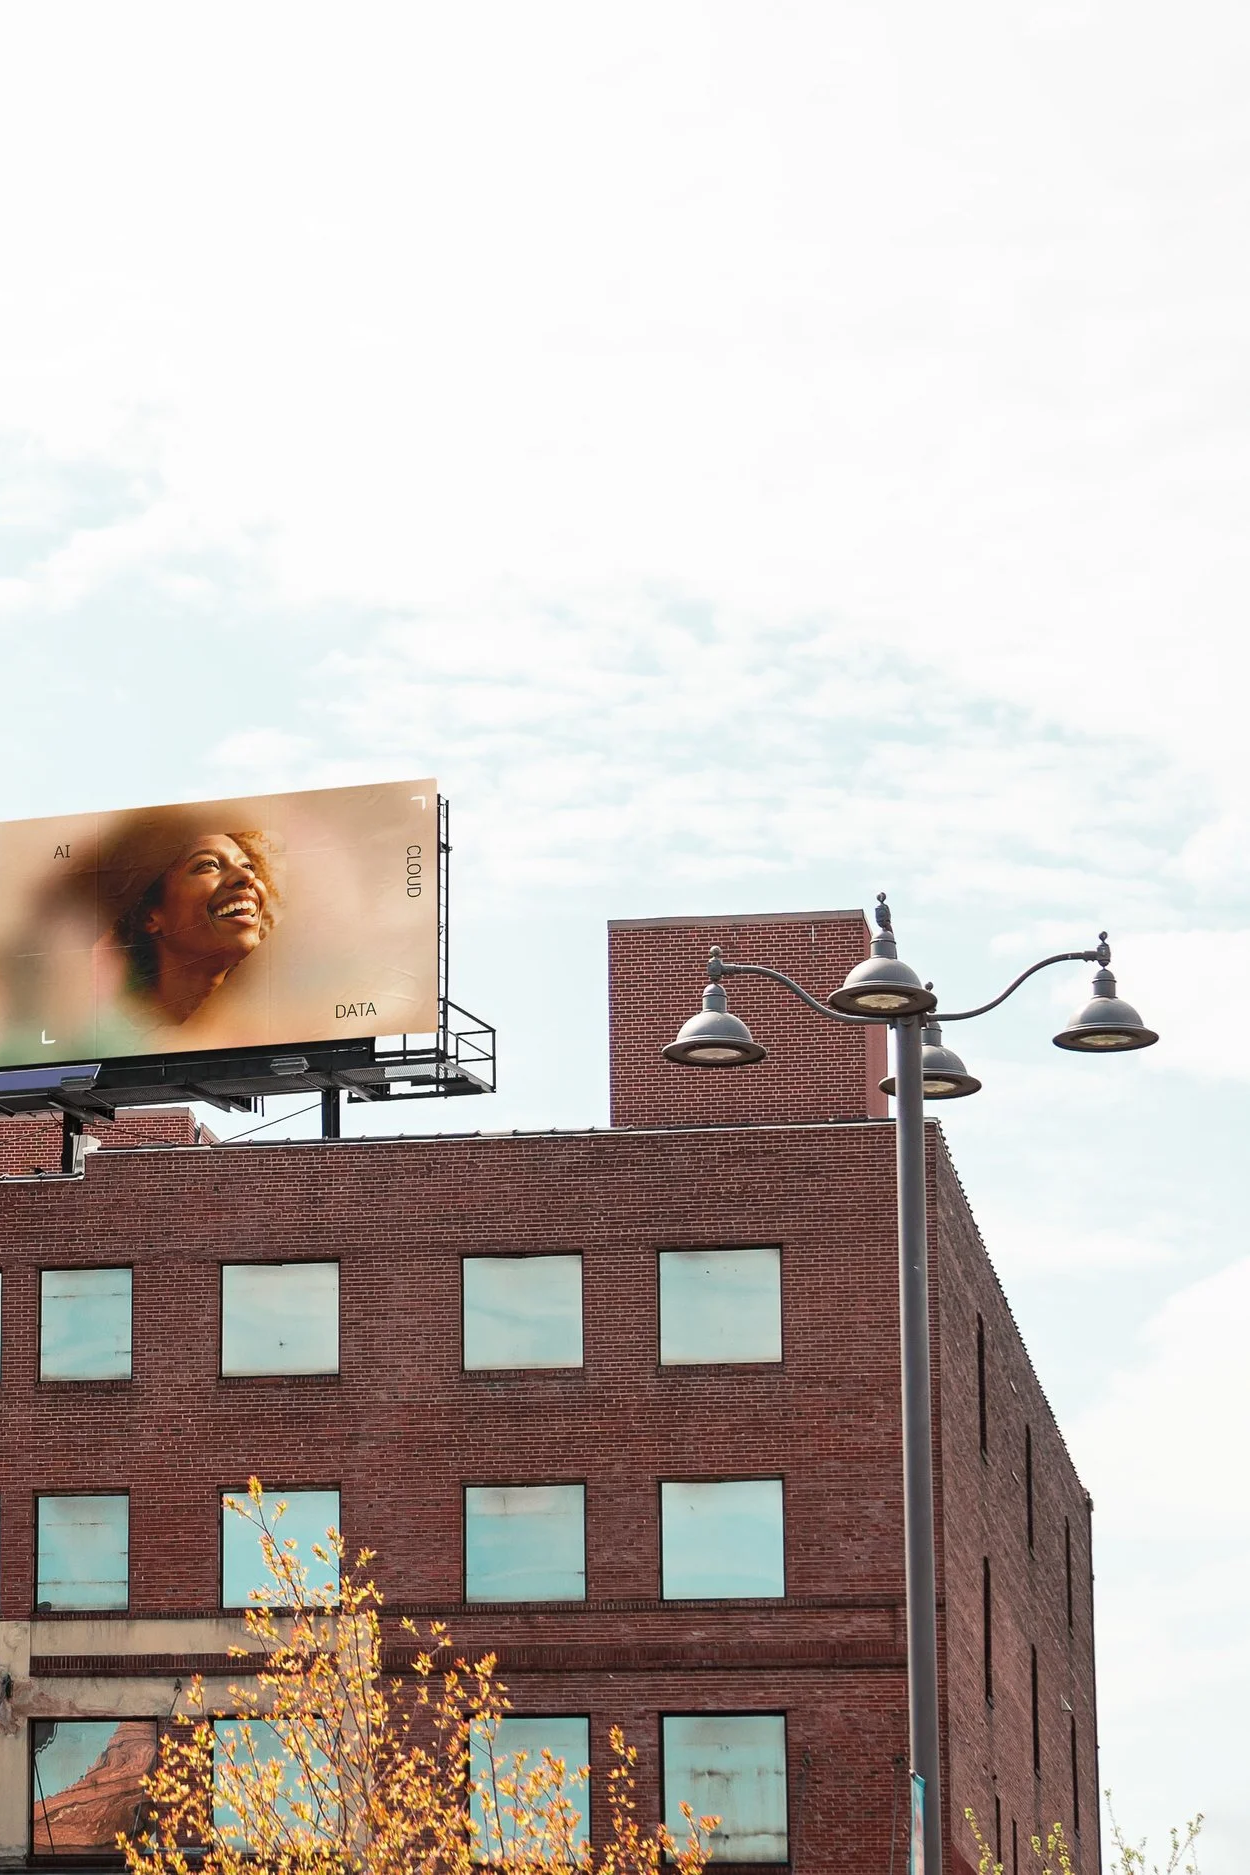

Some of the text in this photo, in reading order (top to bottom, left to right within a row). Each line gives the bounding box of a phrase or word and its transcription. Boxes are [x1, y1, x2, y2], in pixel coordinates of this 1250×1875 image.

[53, 845, 71, 859] AI
[406, 845, 422, 898] CLOUD
[335, 1002, 377, 1019] DATA
